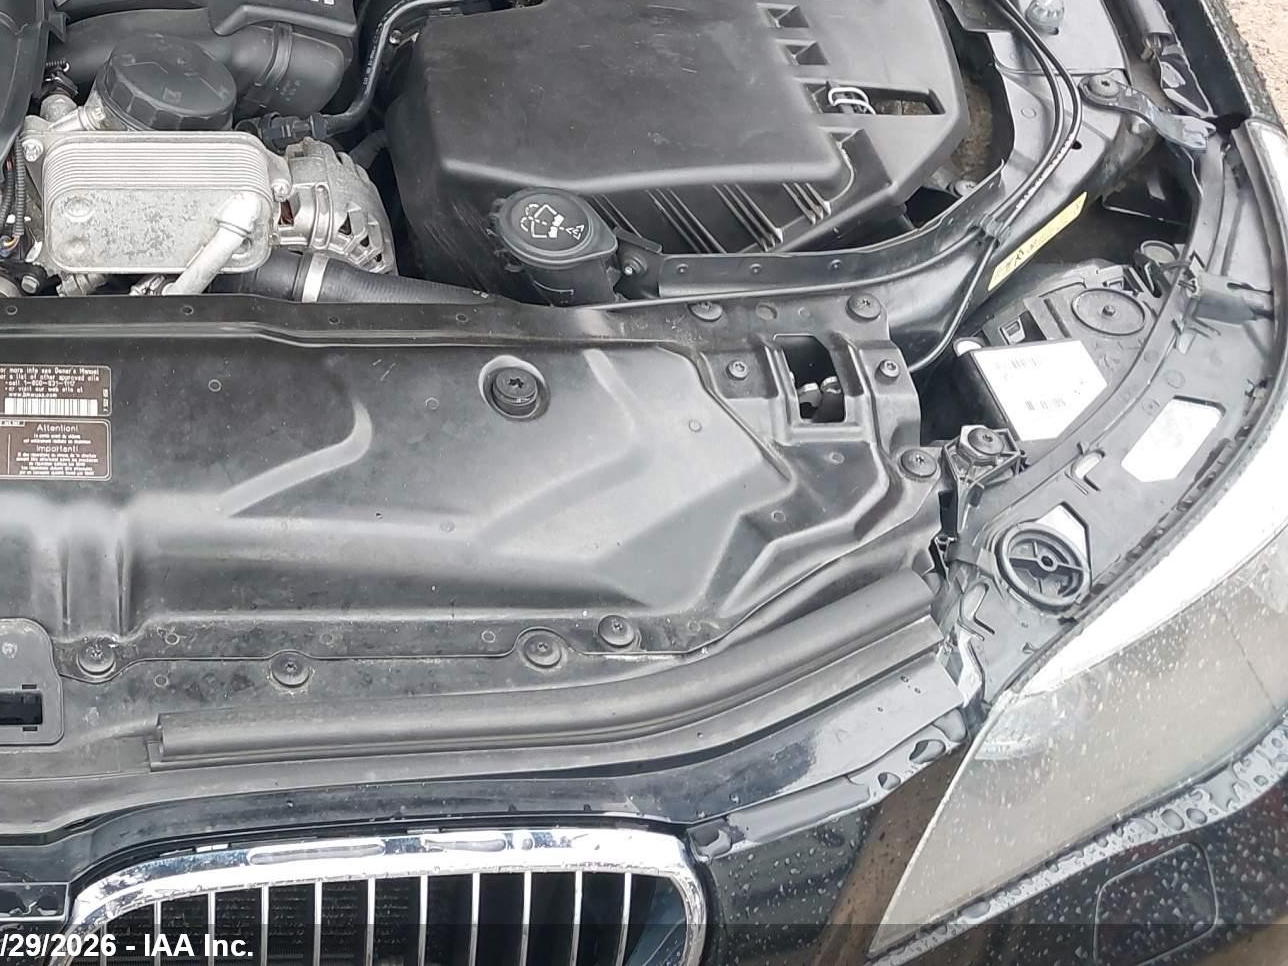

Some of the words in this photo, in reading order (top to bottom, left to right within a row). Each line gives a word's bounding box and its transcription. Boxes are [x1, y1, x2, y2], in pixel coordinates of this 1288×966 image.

[26, 367, 39, 375] info
[37, 424, 79, 432] Attention!
[36, 444, 79, 453] Important!
